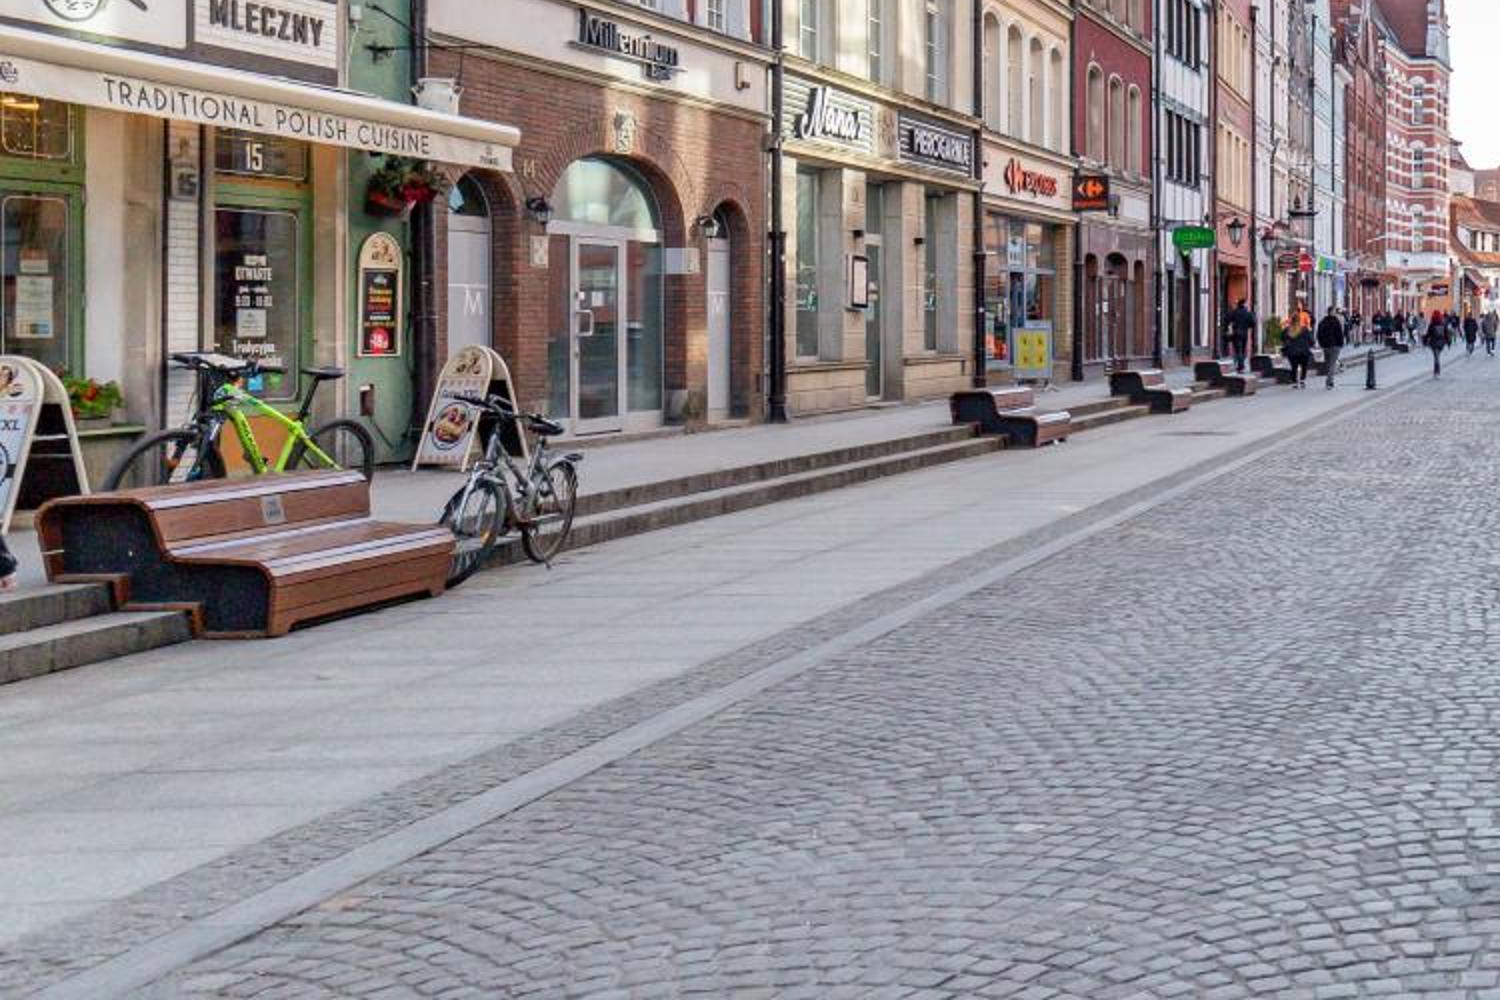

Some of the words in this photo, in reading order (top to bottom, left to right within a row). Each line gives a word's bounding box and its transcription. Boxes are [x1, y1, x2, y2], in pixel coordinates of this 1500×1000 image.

[103, 77, 263, 127] TRADITIONAL
[275, 108, 348, 140] POLISH
[357, 124, 431, 155] CUISINE
[245, 141, 263, 171] 15
